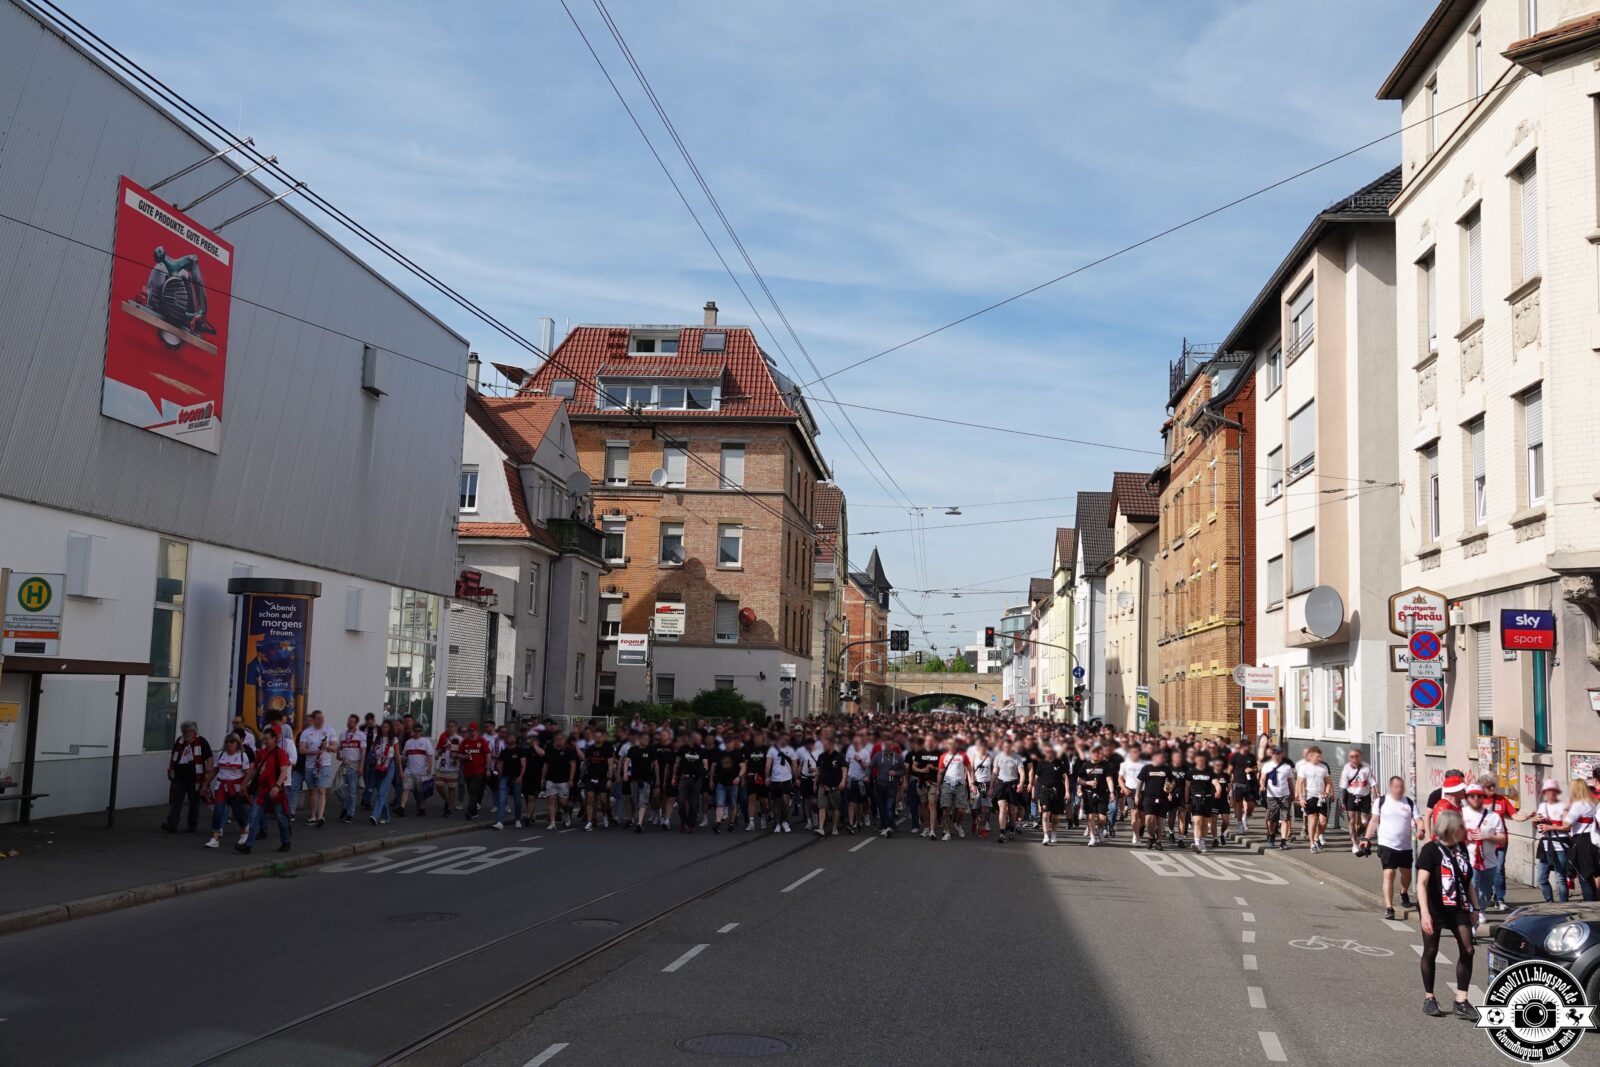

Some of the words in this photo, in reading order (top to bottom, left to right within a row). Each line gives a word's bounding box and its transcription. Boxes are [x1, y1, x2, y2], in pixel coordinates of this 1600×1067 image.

[138, 200, 154, 217] GUTE
[154, 209, 185, 236] PRODUKTE.
[186, 229, 201, 245] GUTE
[200, 238, 220, 257] PREISE.
[178, 406, 205, 424] toom
[26, 585, 43, 604] H
[270, 603, 297, 612] Abends
[281, 611, 293, 619] auf
[1398, 611, 1443, 622] Hfbräu
[1515, 613, 1541, 629] sky
[261, 619, 302, 630] morgens
[1513, 633, 1544, 644] sport
[1129, 850, 1290, 885] BUS
